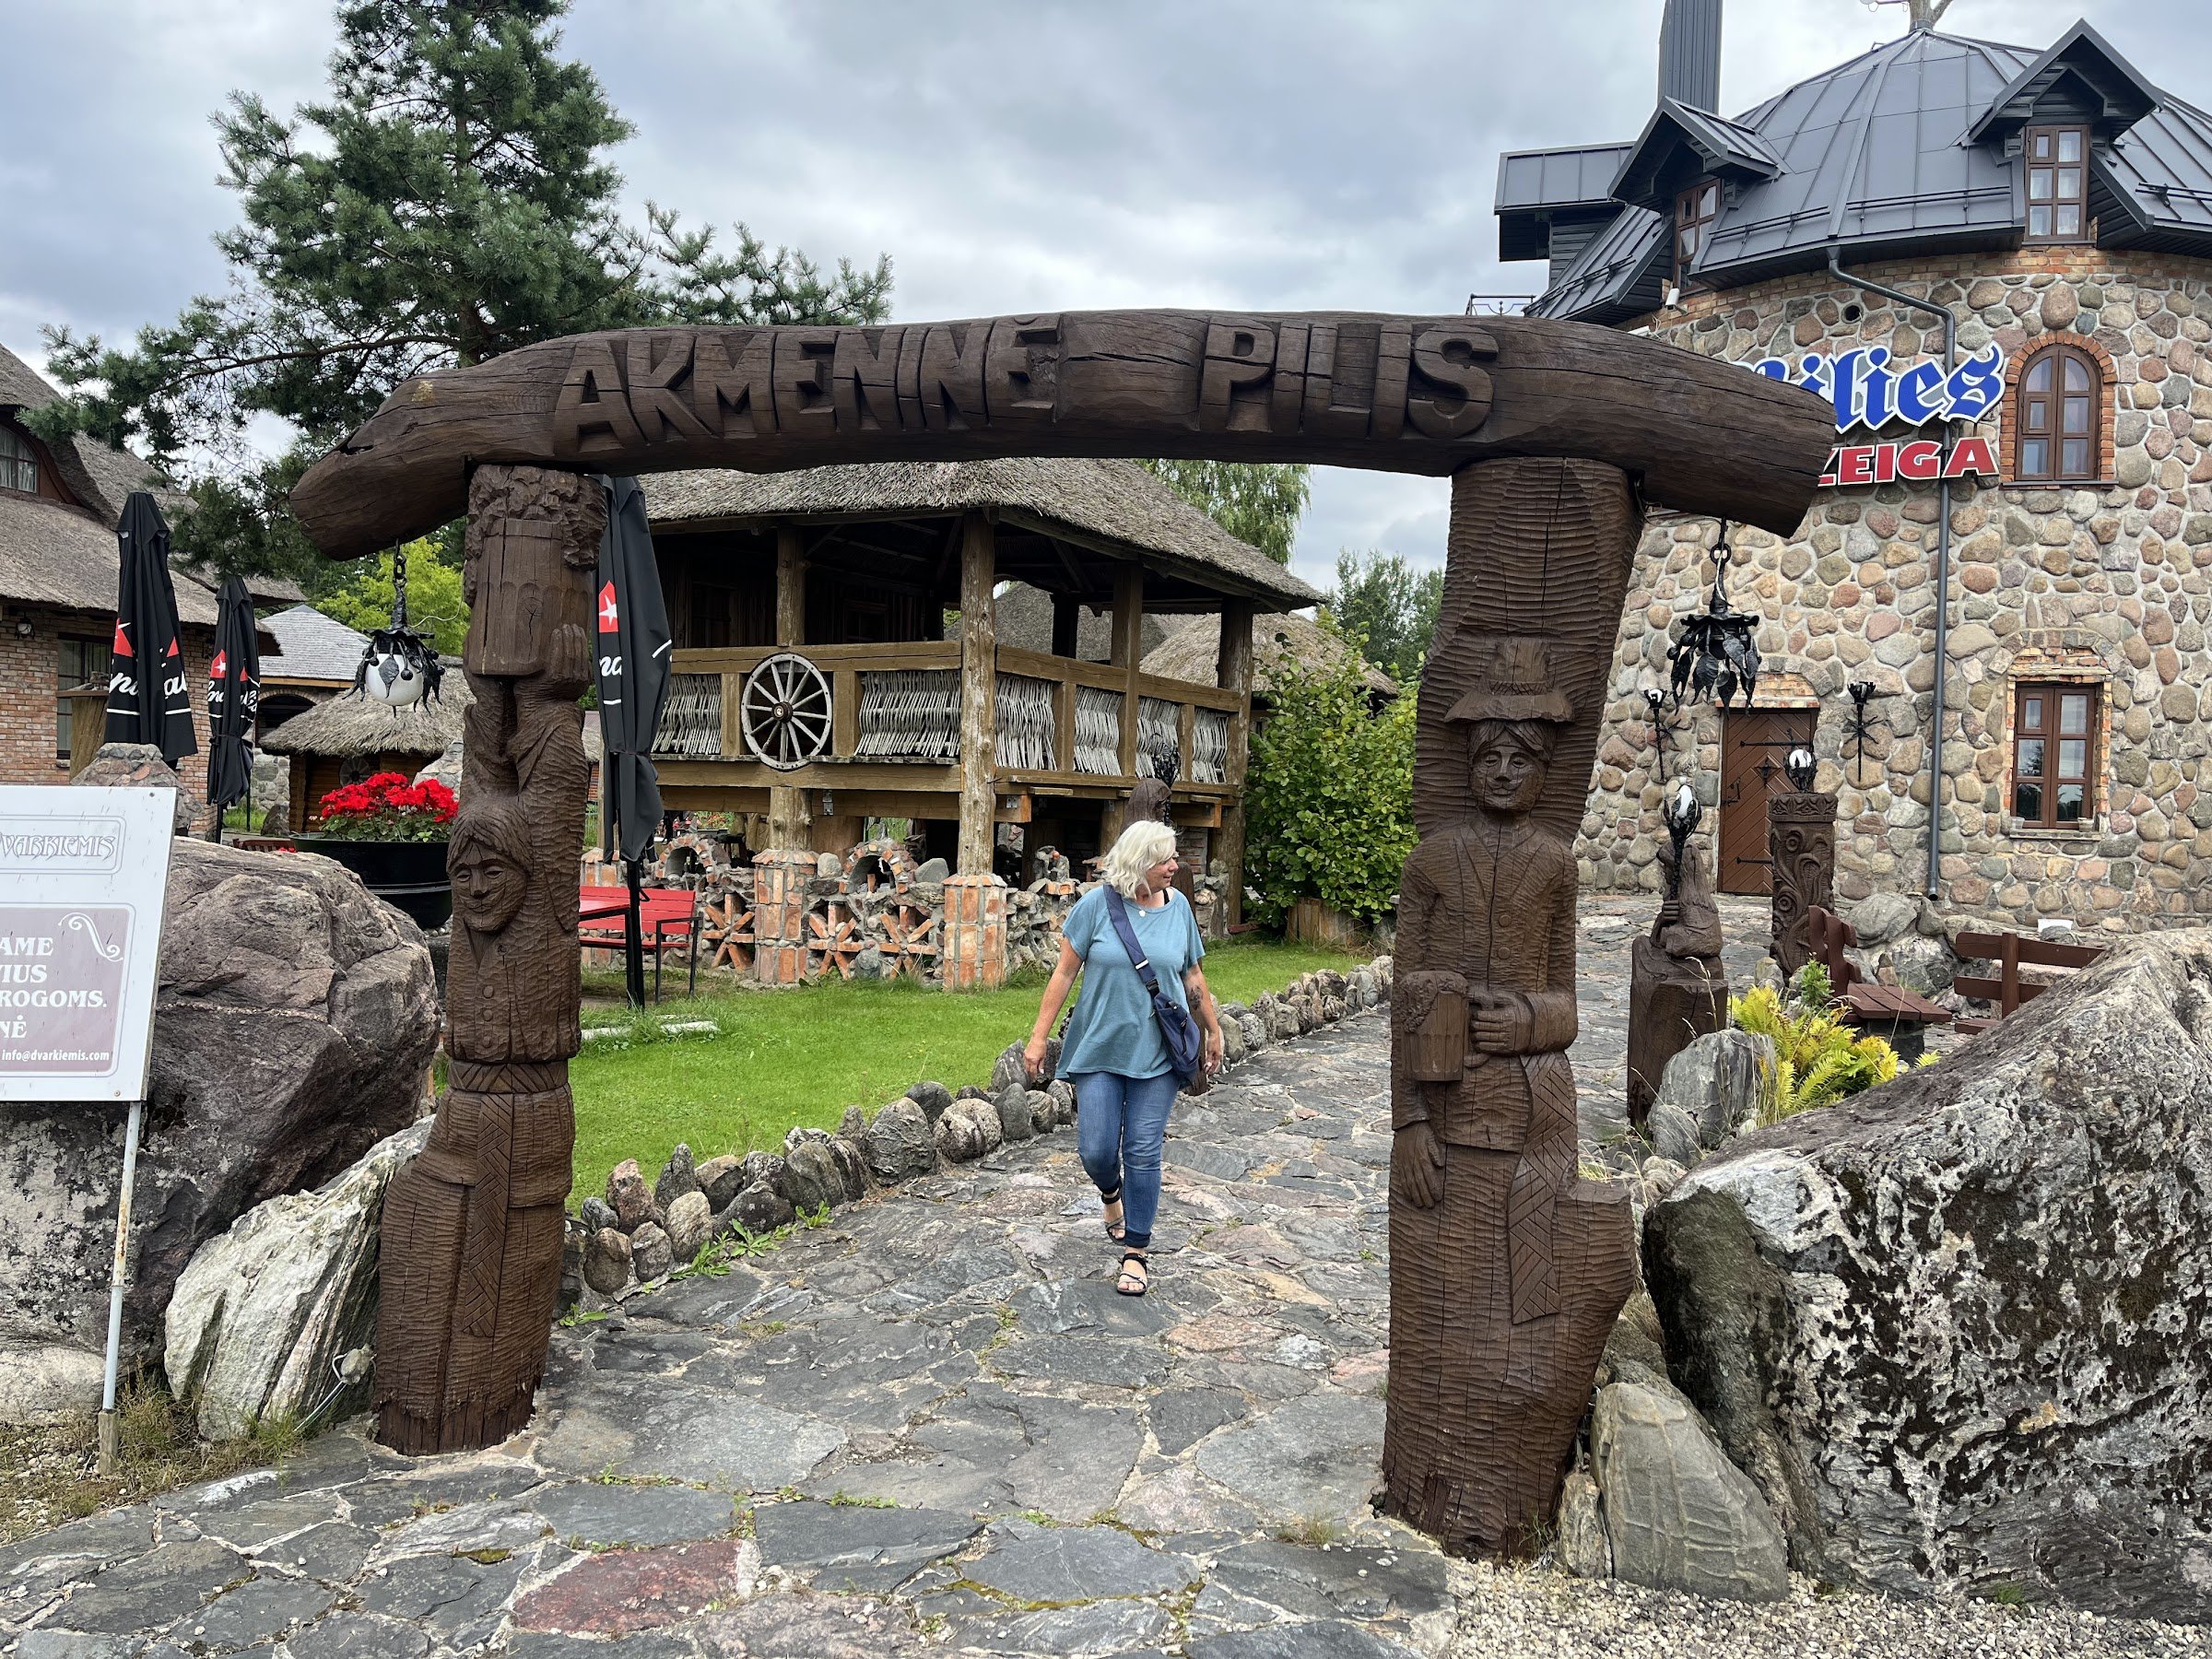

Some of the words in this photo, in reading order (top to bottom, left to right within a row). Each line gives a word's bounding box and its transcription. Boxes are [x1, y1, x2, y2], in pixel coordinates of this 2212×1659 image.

[1200, 315, 1500, 440] PILIS
[0, 833, 116, 861] VARKIEMIS
[0, 964, 47, 983] IUS
[2, 1049, 110, 1062] info@dvarkiemis.com
